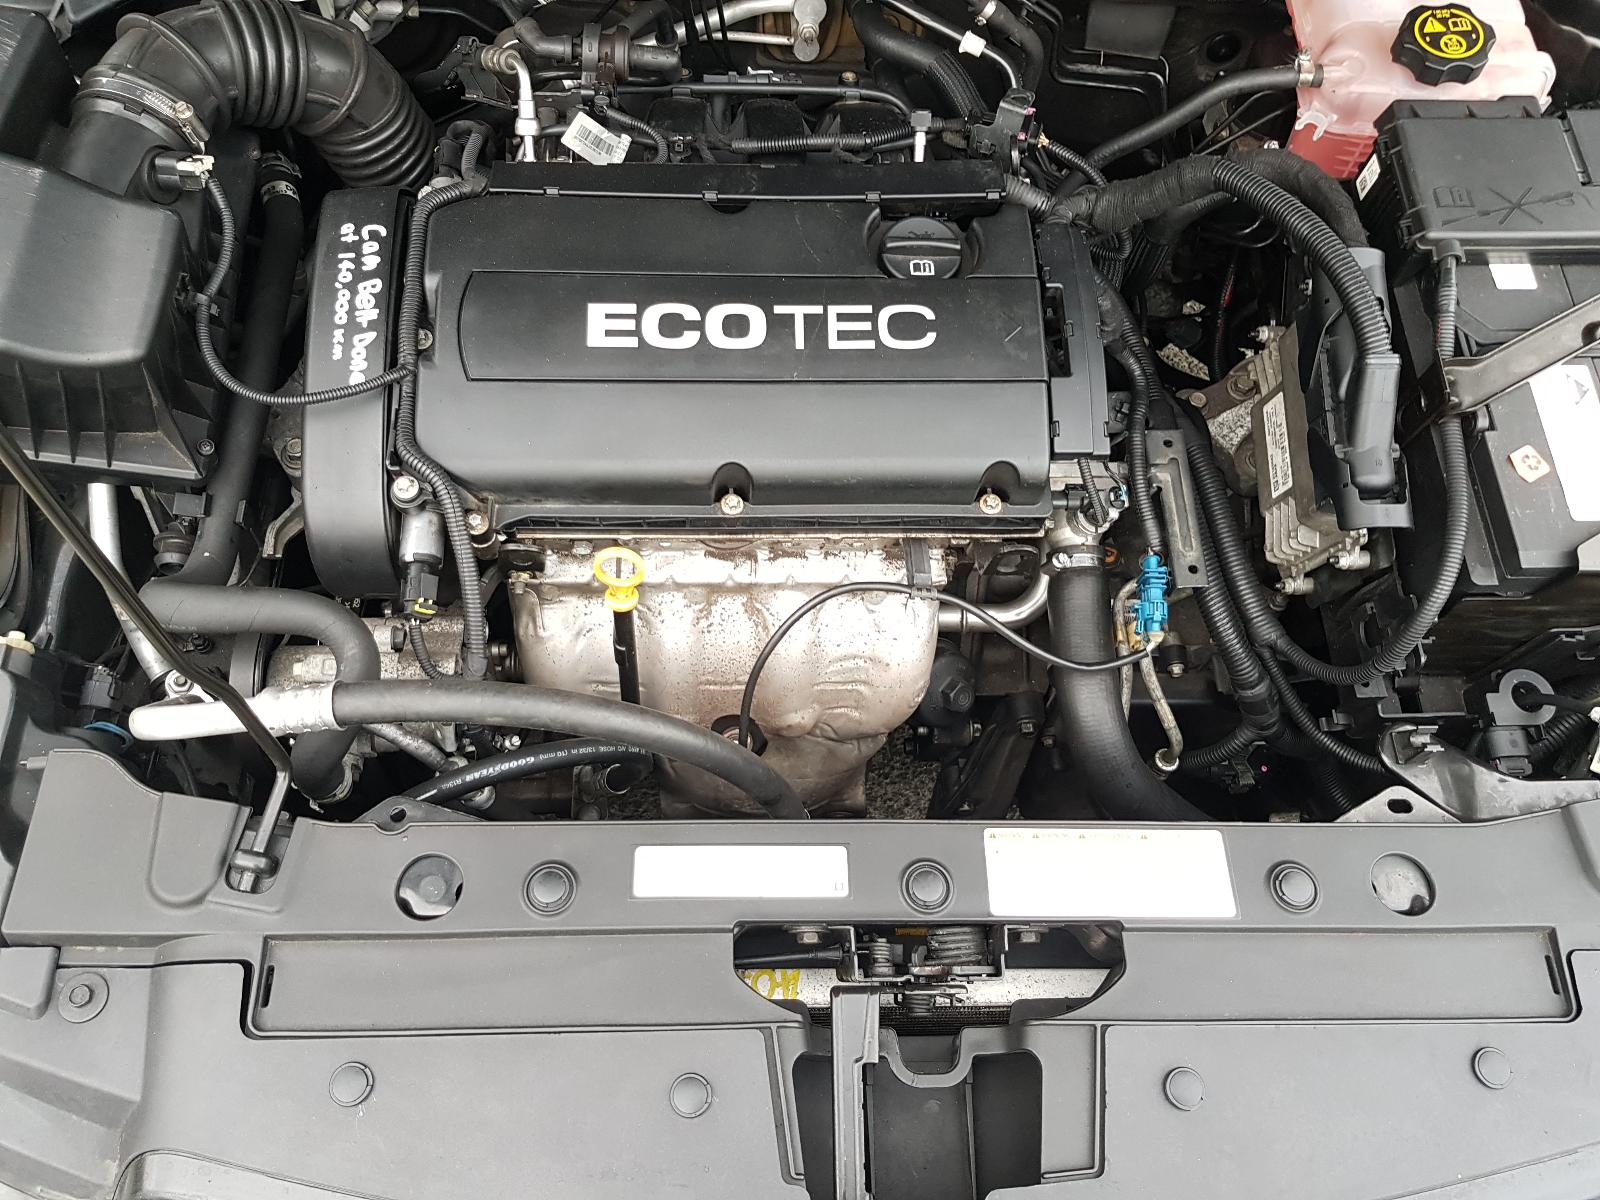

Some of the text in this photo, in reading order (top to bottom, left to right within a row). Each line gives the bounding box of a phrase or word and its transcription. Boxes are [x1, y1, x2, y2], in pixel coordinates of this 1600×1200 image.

[340, 222, 360, 242] at
[361, 224, 387, 271] Cam
[354, 277, 383, 328] Belt
[586, 302, 938, 350] ECOTEC
[465, 755, 535, 782] GOODYEAR
